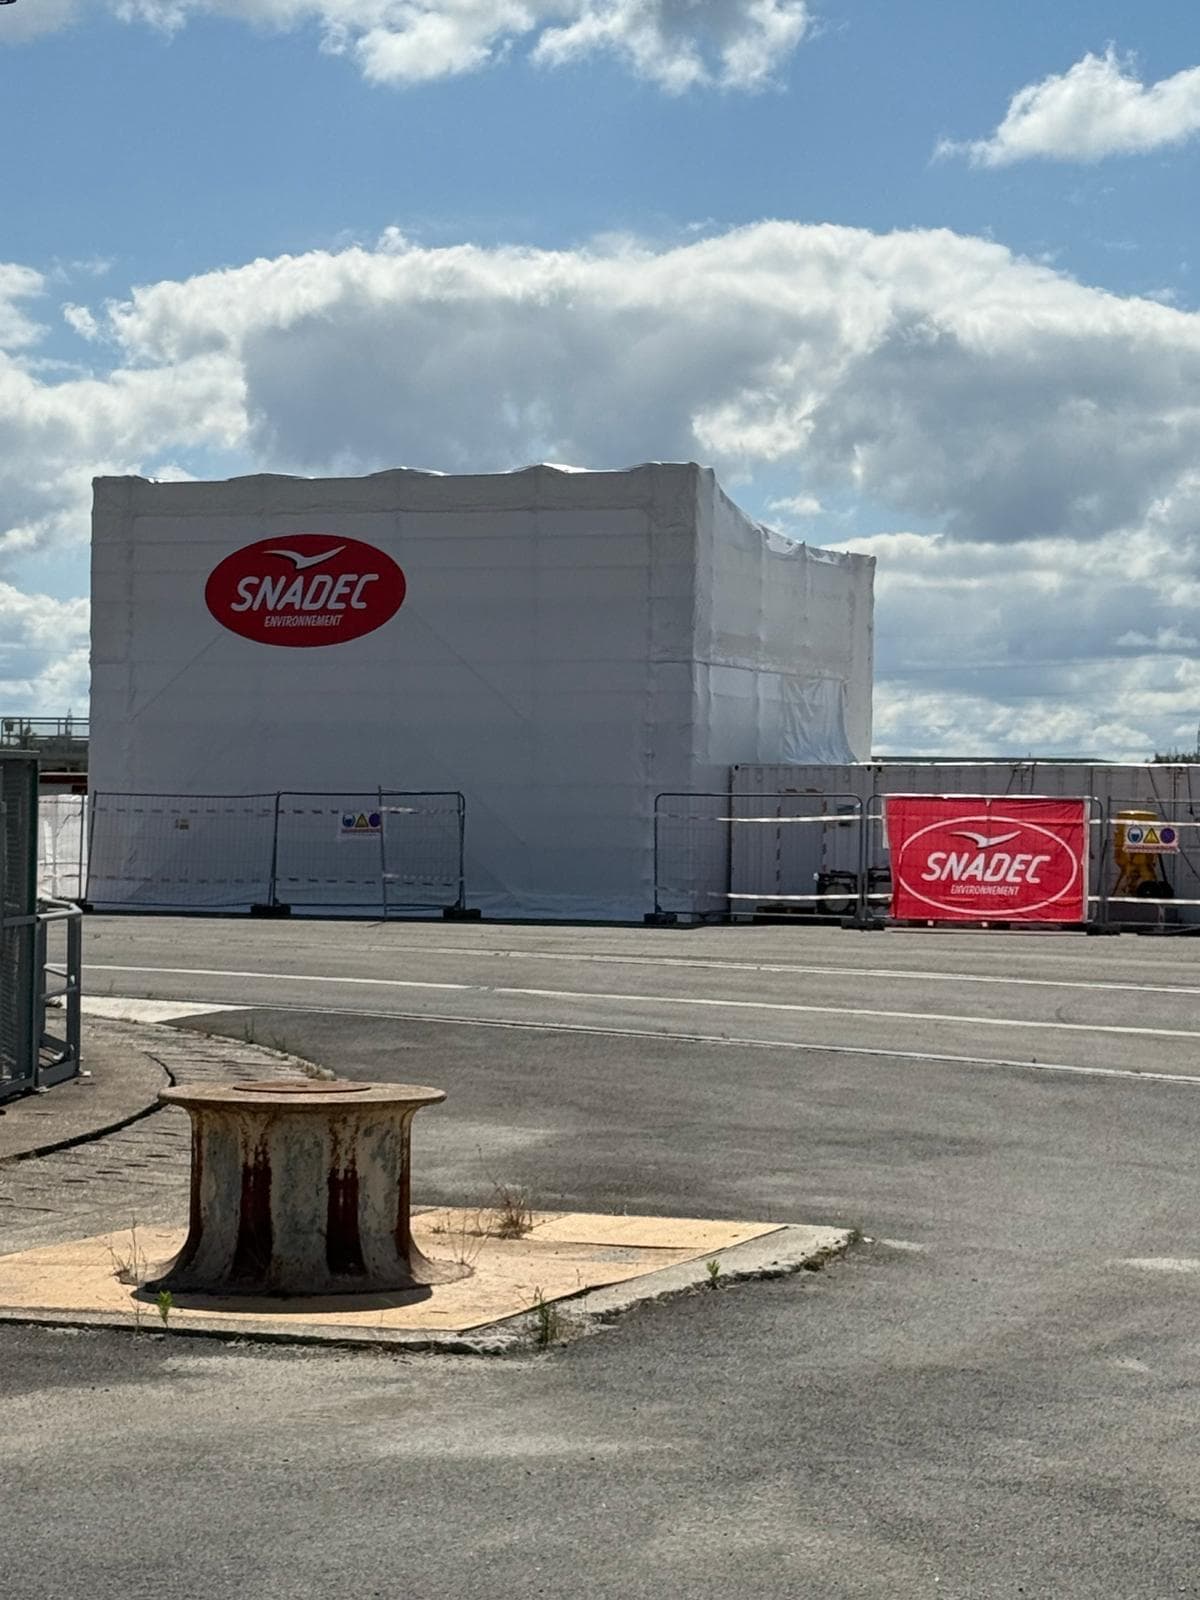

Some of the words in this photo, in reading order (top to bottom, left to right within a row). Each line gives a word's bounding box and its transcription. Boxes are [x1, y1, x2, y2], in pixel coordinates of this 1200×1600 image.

[231, 573, 379, 612] SNADEC
[264, 614, 343, 628] ENVIRONNEMENT
[921, 852, 1051, 884] SNADEC
[950, 884, 1020, 896] ENVIRONNEMENT
